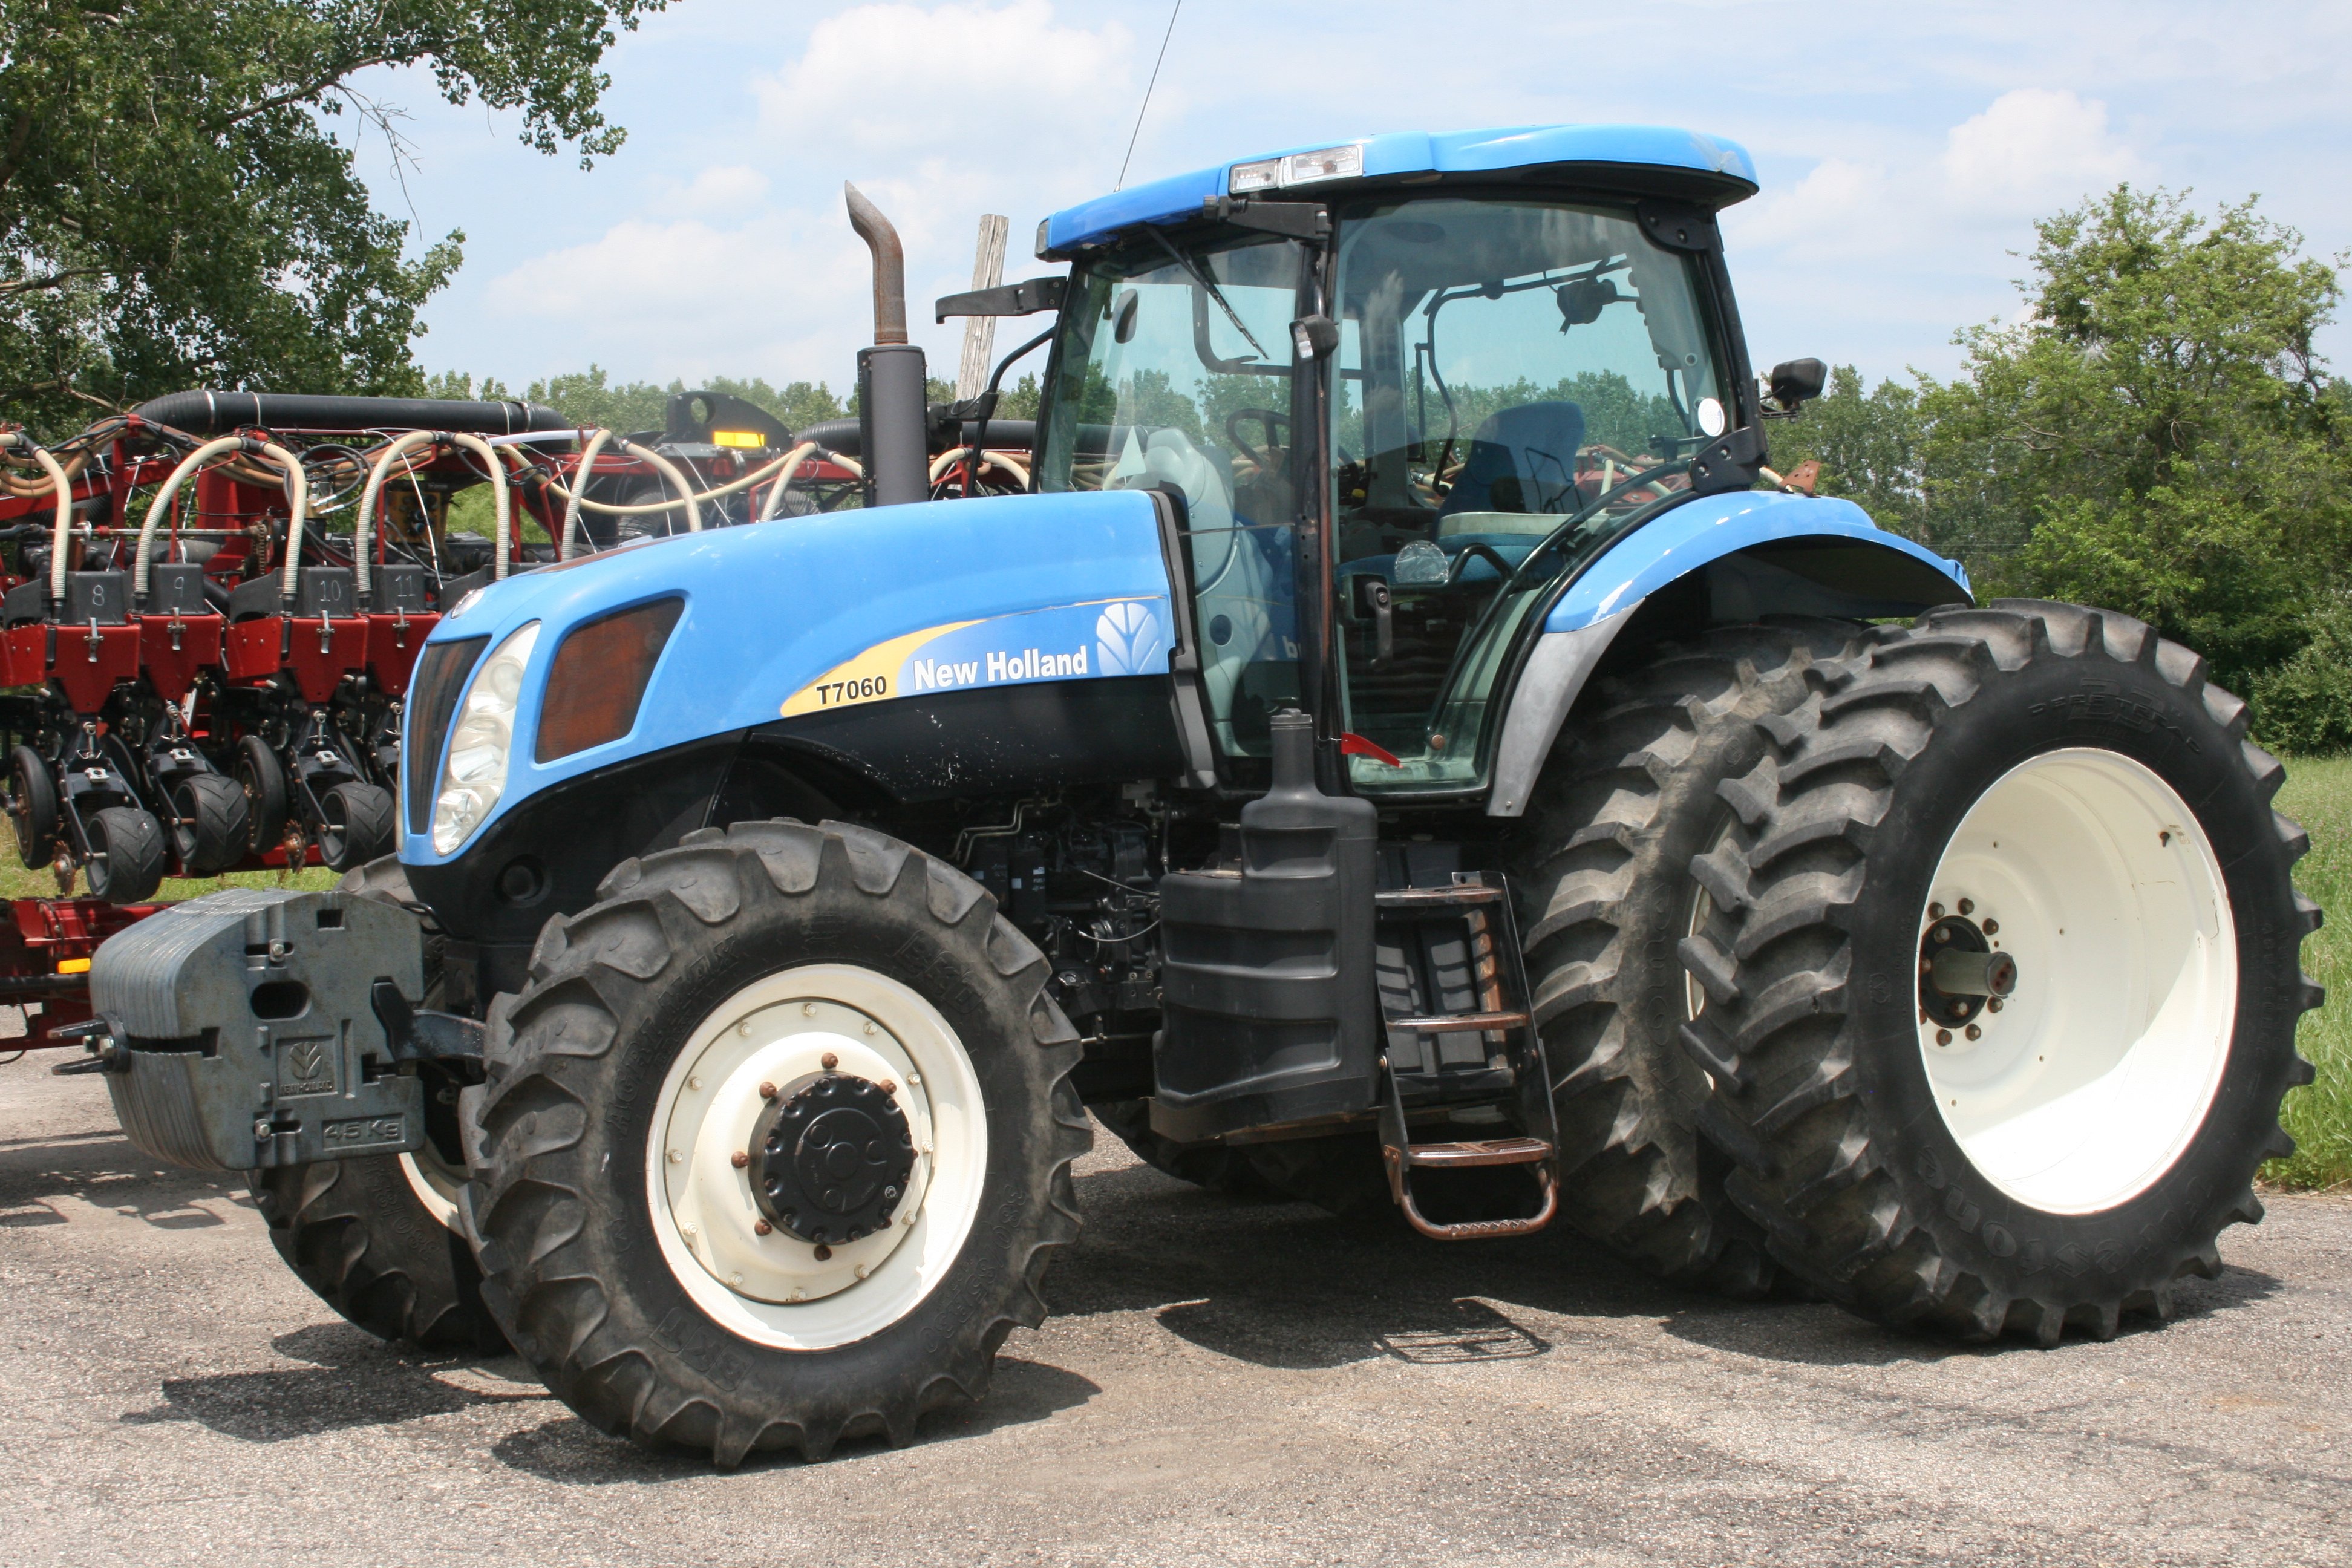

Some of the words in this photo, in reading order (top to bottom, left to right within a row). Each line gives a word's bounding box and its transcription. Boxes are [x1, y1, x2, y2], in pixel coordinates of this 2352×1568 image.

[93, 584, 105, 606] 8
[174, 576, 184, 598] 9
[320, 580, 341, 602] 10
[395, 575, 416, 597] 11
[913, 659, 978, 690] New
[986, 645, 1088, 682] Holland
[816, 676, 887, 705] T7060
[324, 1122, 361, 1141] 45
